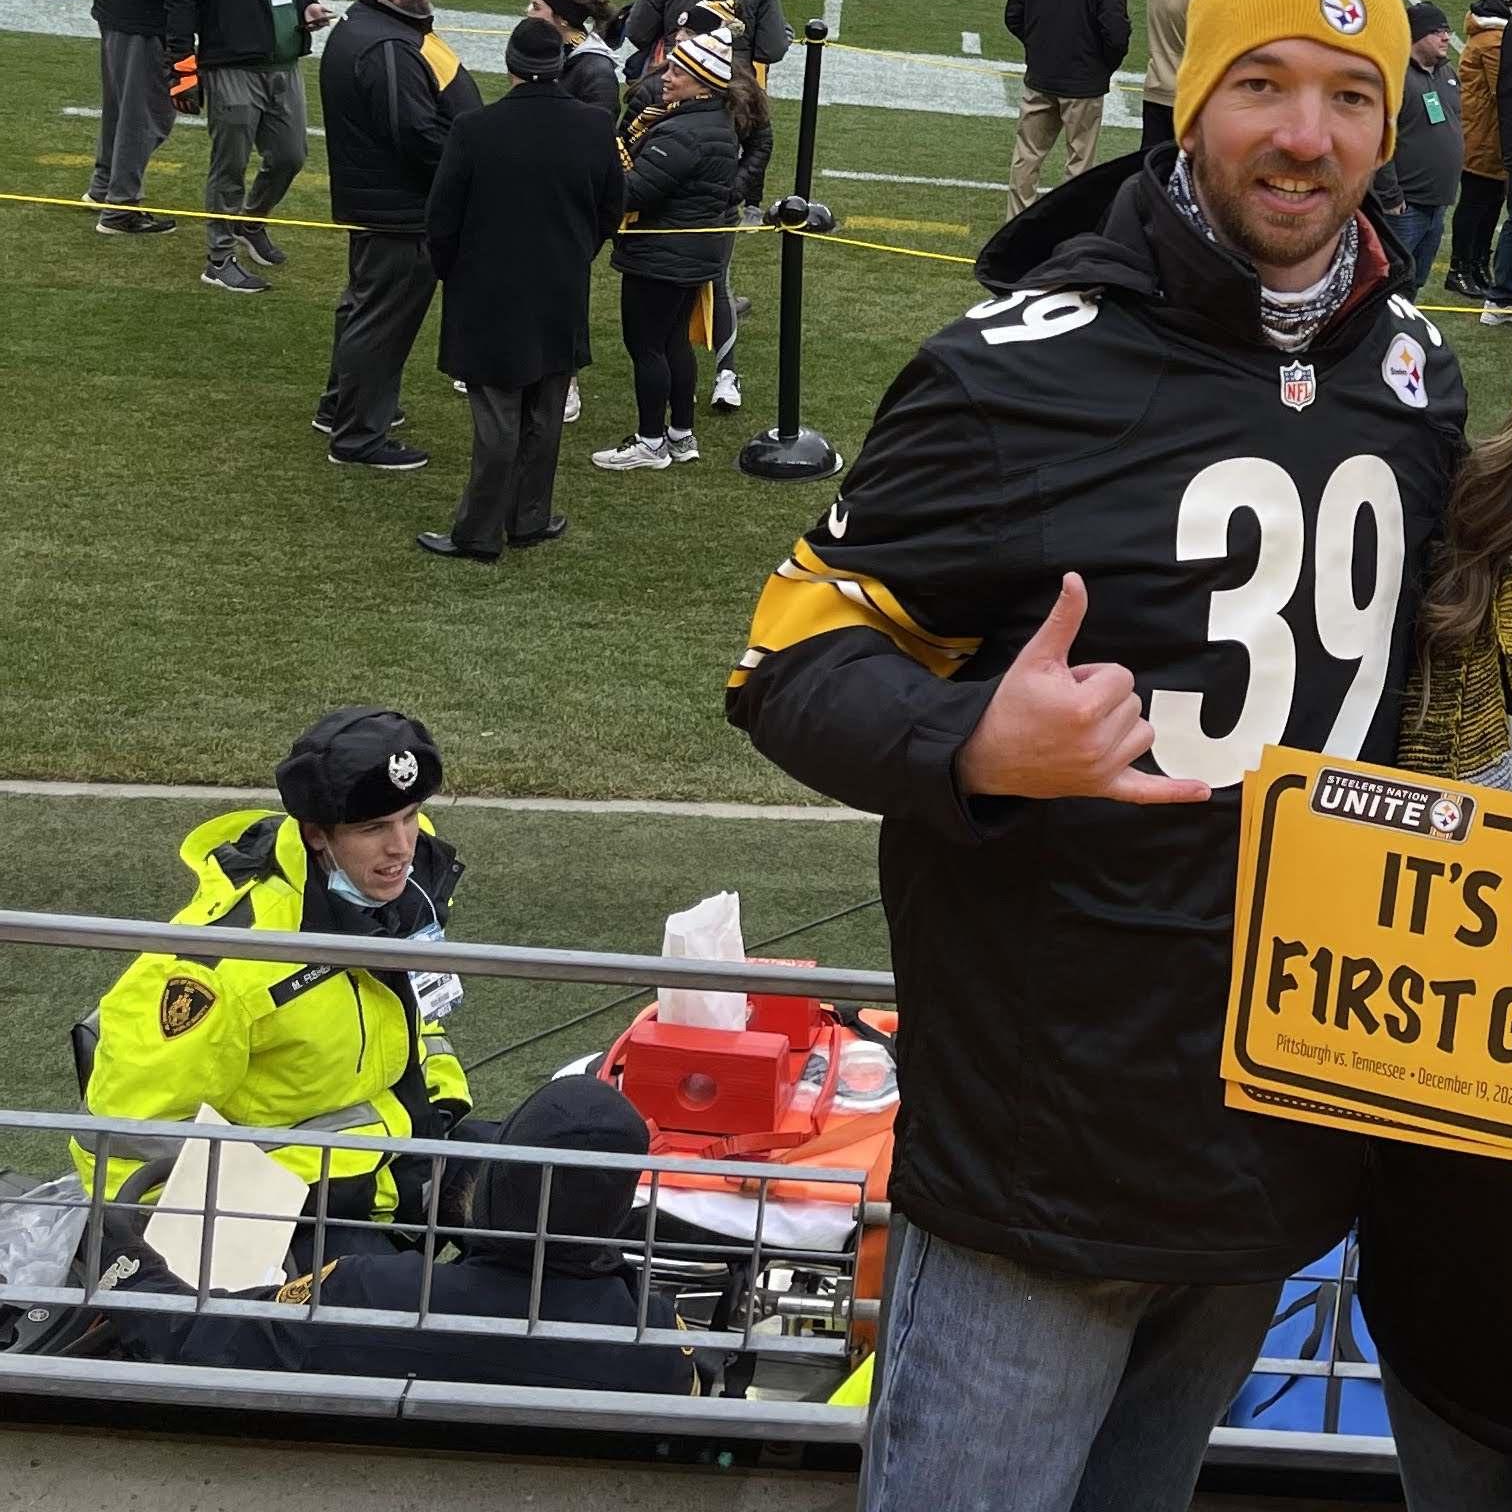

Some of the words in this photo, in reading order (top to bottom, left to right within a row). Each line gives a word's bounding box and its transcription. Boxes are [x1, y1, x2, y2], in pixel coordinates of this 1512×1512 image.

[1148, 454, 1406, 789] 39
[1320, 784, 1426, 827] UNITE
[1326, 775, 1385, 794] STEELERS
[1386, 787, 1429, 802] NATION
[1376, 851, 1502, 949] IT'S
[1276, 1033, 1331, 1065] Pittsburgh
[1333, 1051, 1348, 1068] vs.
[1351, 1050, 1406, 1081] Tennessee
[1417, 1066, 1474, 1096] December
[1475, 1080, 1490, 1103] 19,
